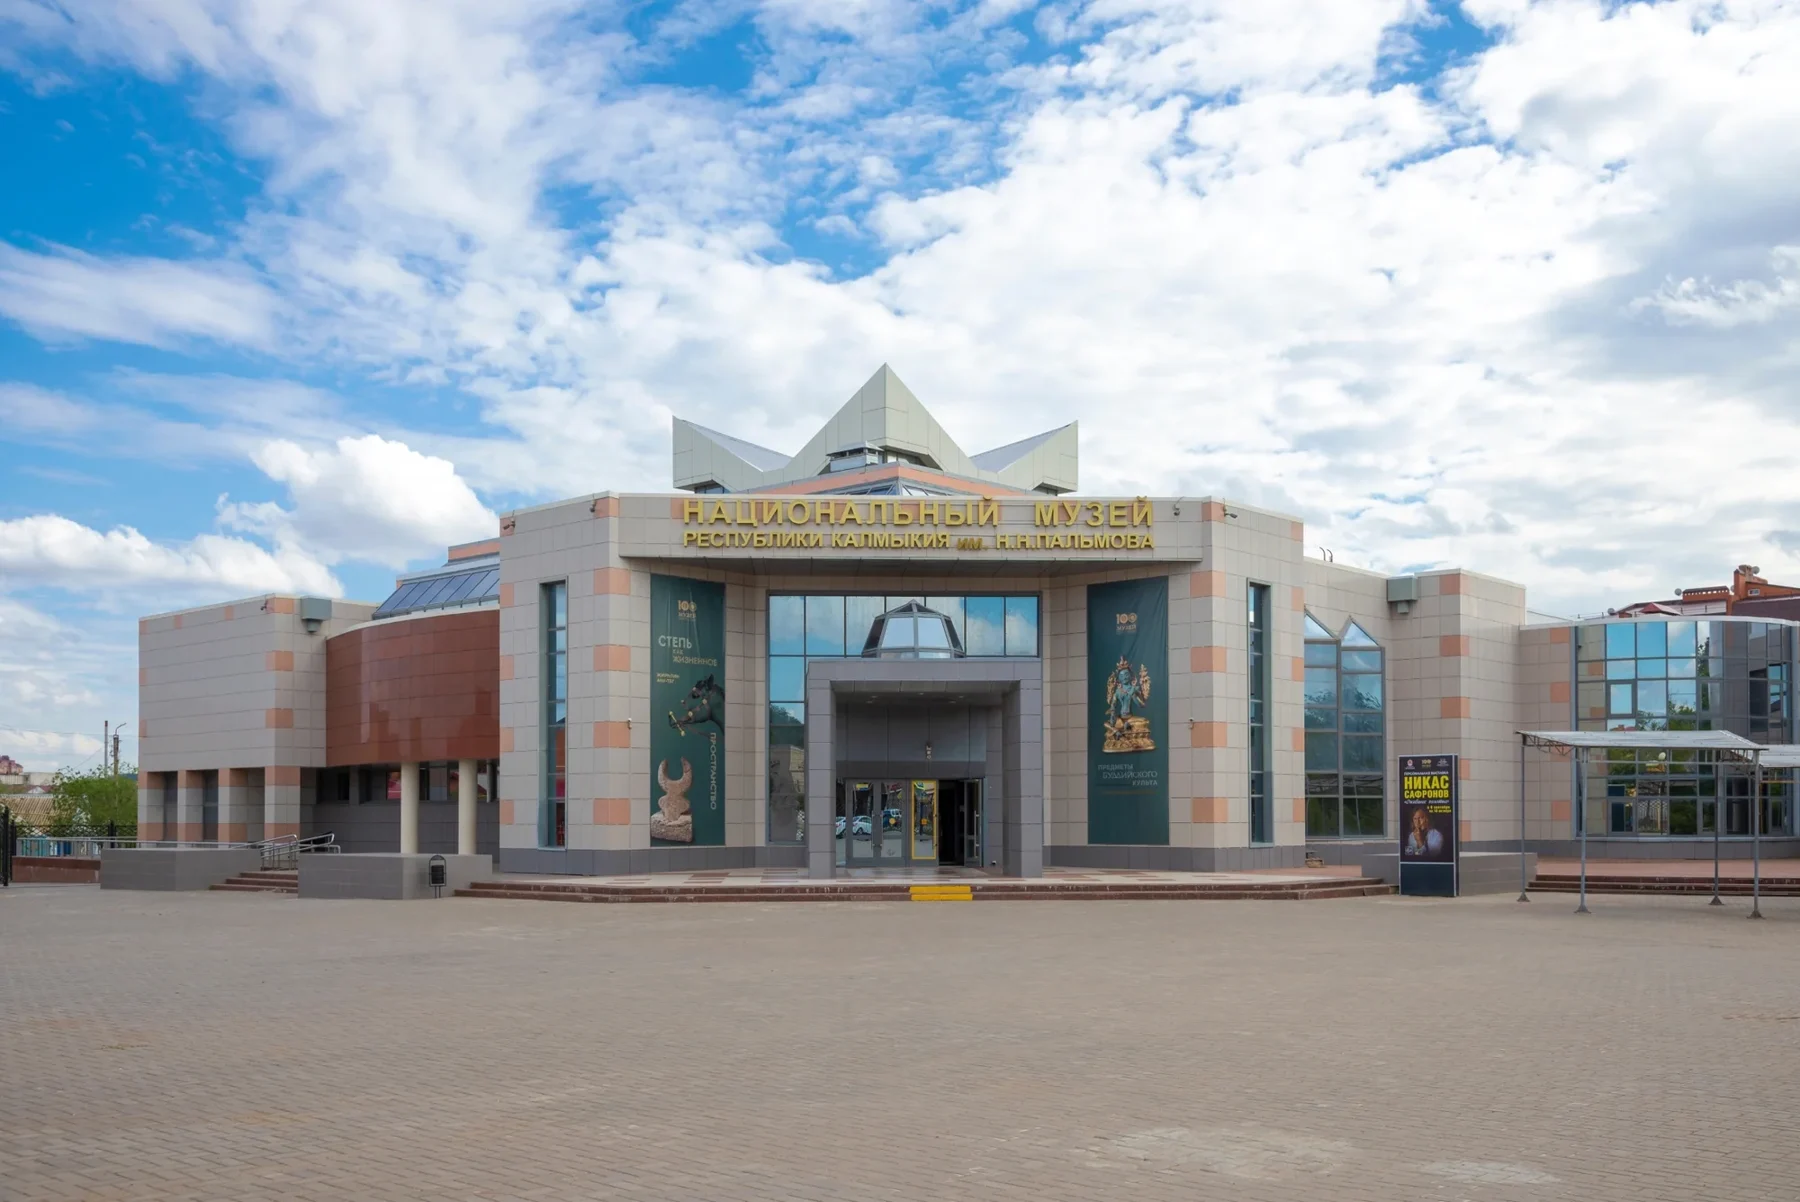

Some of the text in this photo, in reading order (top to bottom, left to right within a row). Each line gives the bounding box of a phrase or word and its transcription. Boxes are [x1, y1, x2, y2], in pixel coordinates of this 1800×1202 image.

[682, 495, 1154, 527] НАЦИОНАЛЬНЫЙ МУЗЕЙ
[682, 531, 825, 548] РЕСПУБЛИКИ
[830, 531, 951, 549] КАЛМЫКИЯ
[996, 533, 1155, 550] Н.Н.ПАЛЬМОВА
[678, 600, 697, 612] 100
[1116, 612, 1137, 624] 100
[658, 635, 692, 649] СТЕПЬ
[672, 655, 718, 667] ЖИЗНЕННОЕ
[709, 732, 717, 810] ПРОСТРАНСТВО
[1097, 763, 1134, 771] ПРЕДМЕТЫ
[1102, 769, 1158, 779] БУДДИЙСКОГО
[1404, 775, 1449, 790] НИКАС
[1404, 789, 1449, 799] САФРОНОВ
